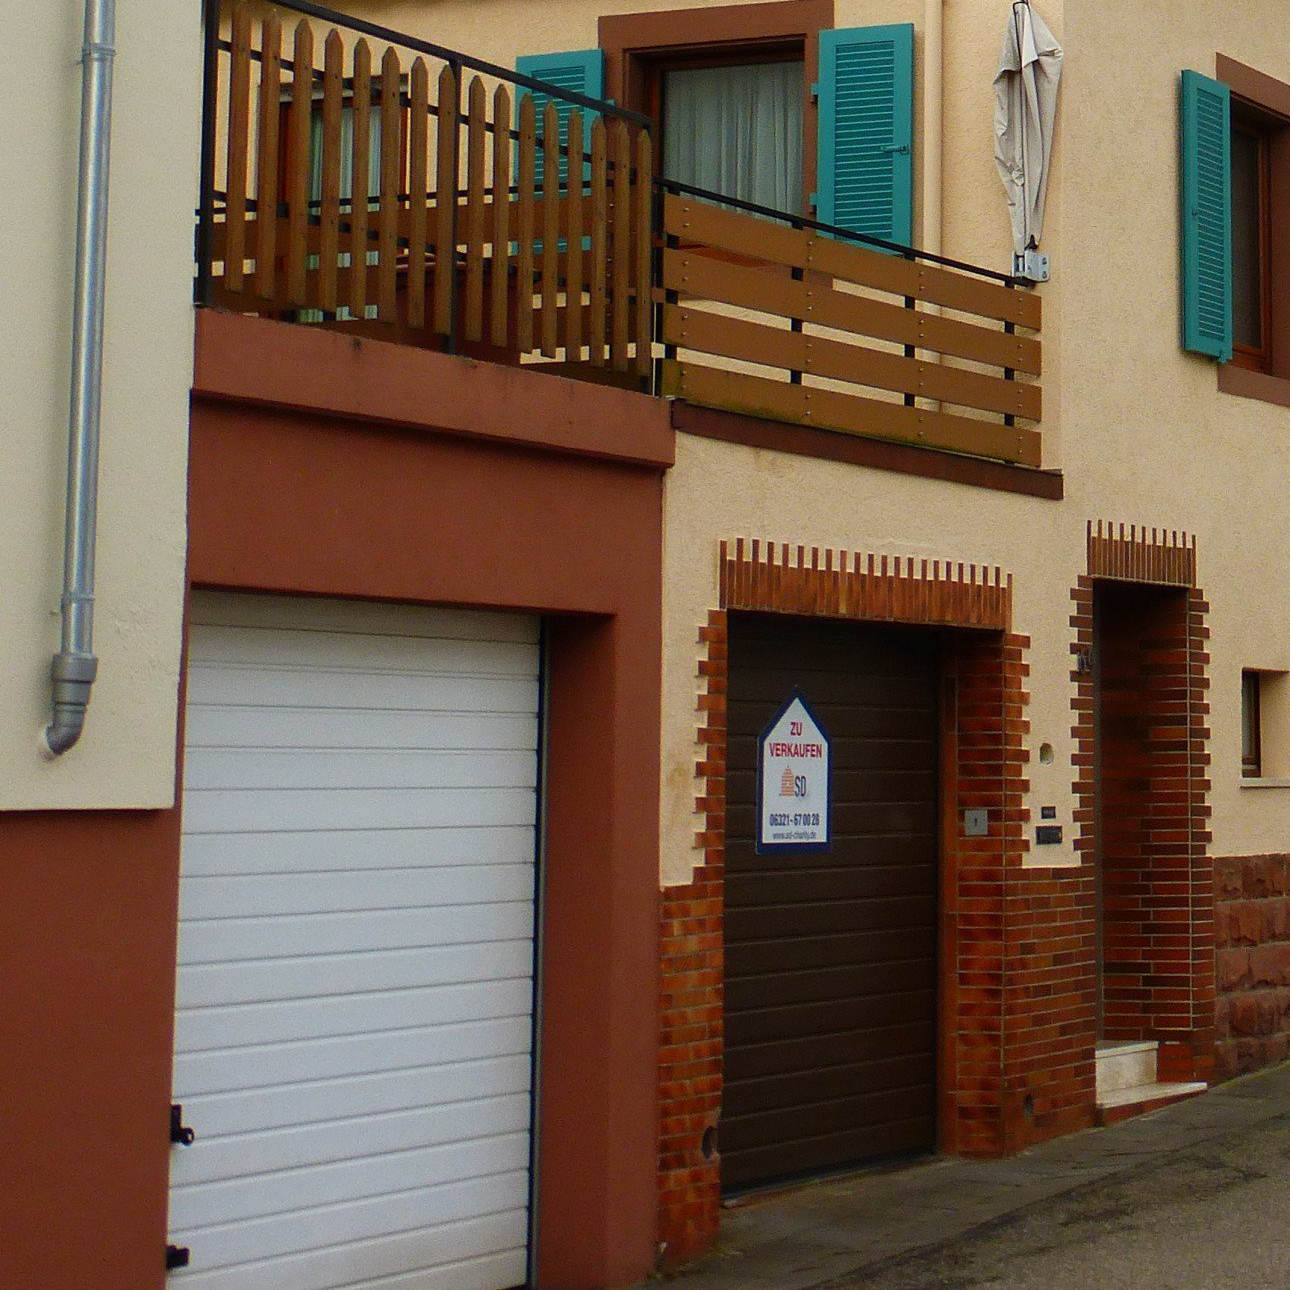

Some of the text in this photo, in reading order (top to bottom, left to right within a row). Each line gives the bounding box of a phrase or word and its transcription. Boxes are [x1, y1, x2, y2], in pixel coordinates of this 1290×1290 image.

[790, 722, 803, 736] ZU
[769, 743, 822, 757] VERKAUFEN
[795, 776, 807, 797] SD
